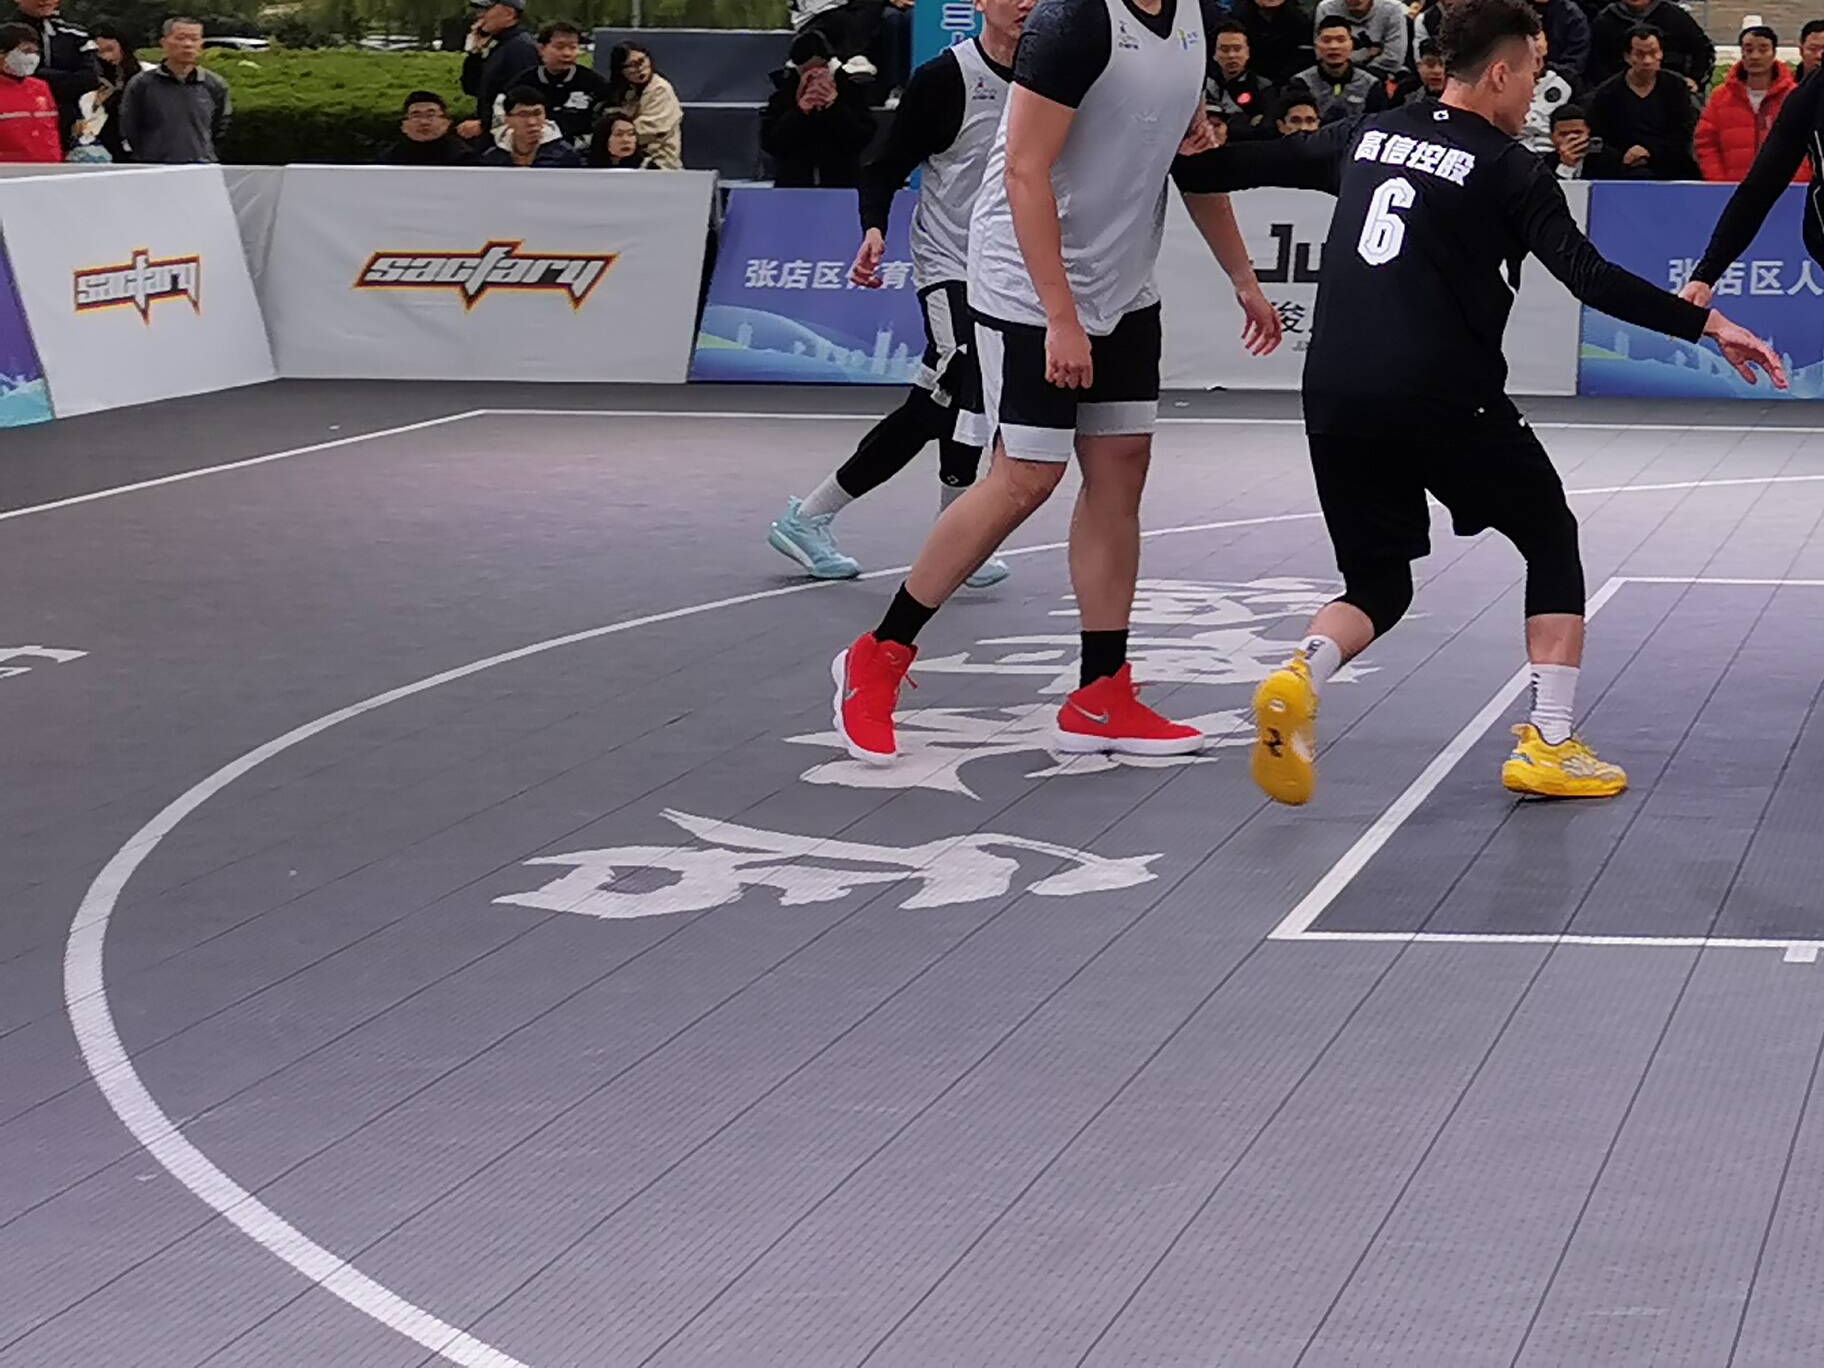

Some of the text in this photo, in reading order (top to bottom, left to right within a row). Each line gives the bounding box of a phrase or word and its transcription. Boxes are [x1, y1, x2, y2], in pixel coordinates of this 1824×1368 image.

[1357, 176, 1416, 265] 6
[744, 259, 914, 289] 张店区育
